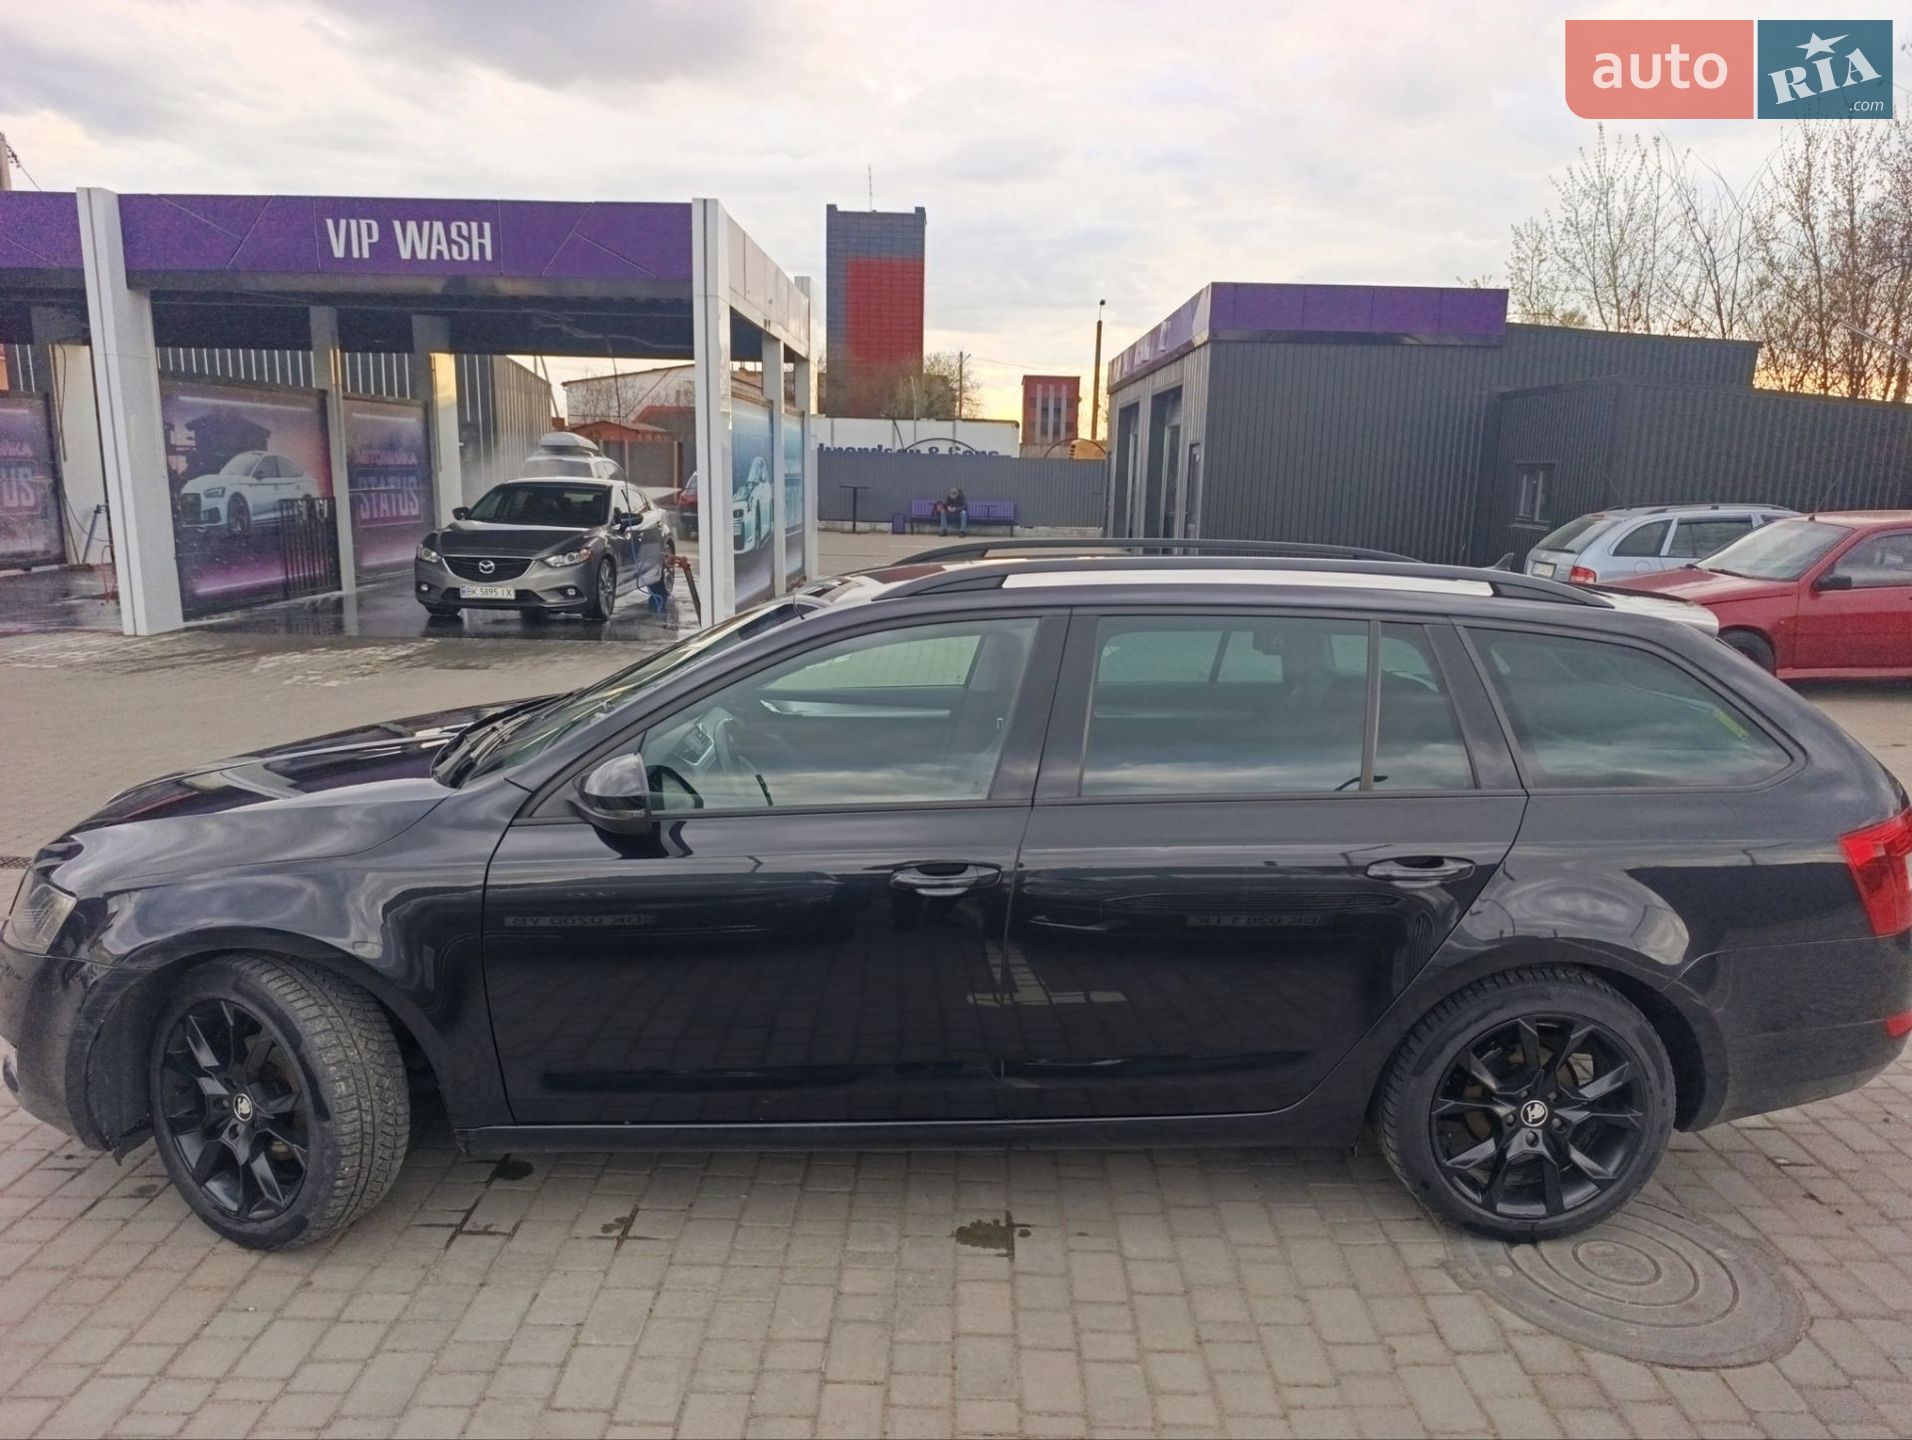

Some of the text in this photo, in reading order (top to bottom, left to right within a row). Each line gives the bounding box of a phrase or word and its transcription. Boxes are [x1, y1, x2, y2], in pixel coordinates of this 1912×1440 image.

[325, 218, 492, 261] VIP WASH
[357, 475, 419, 519] STATUS
